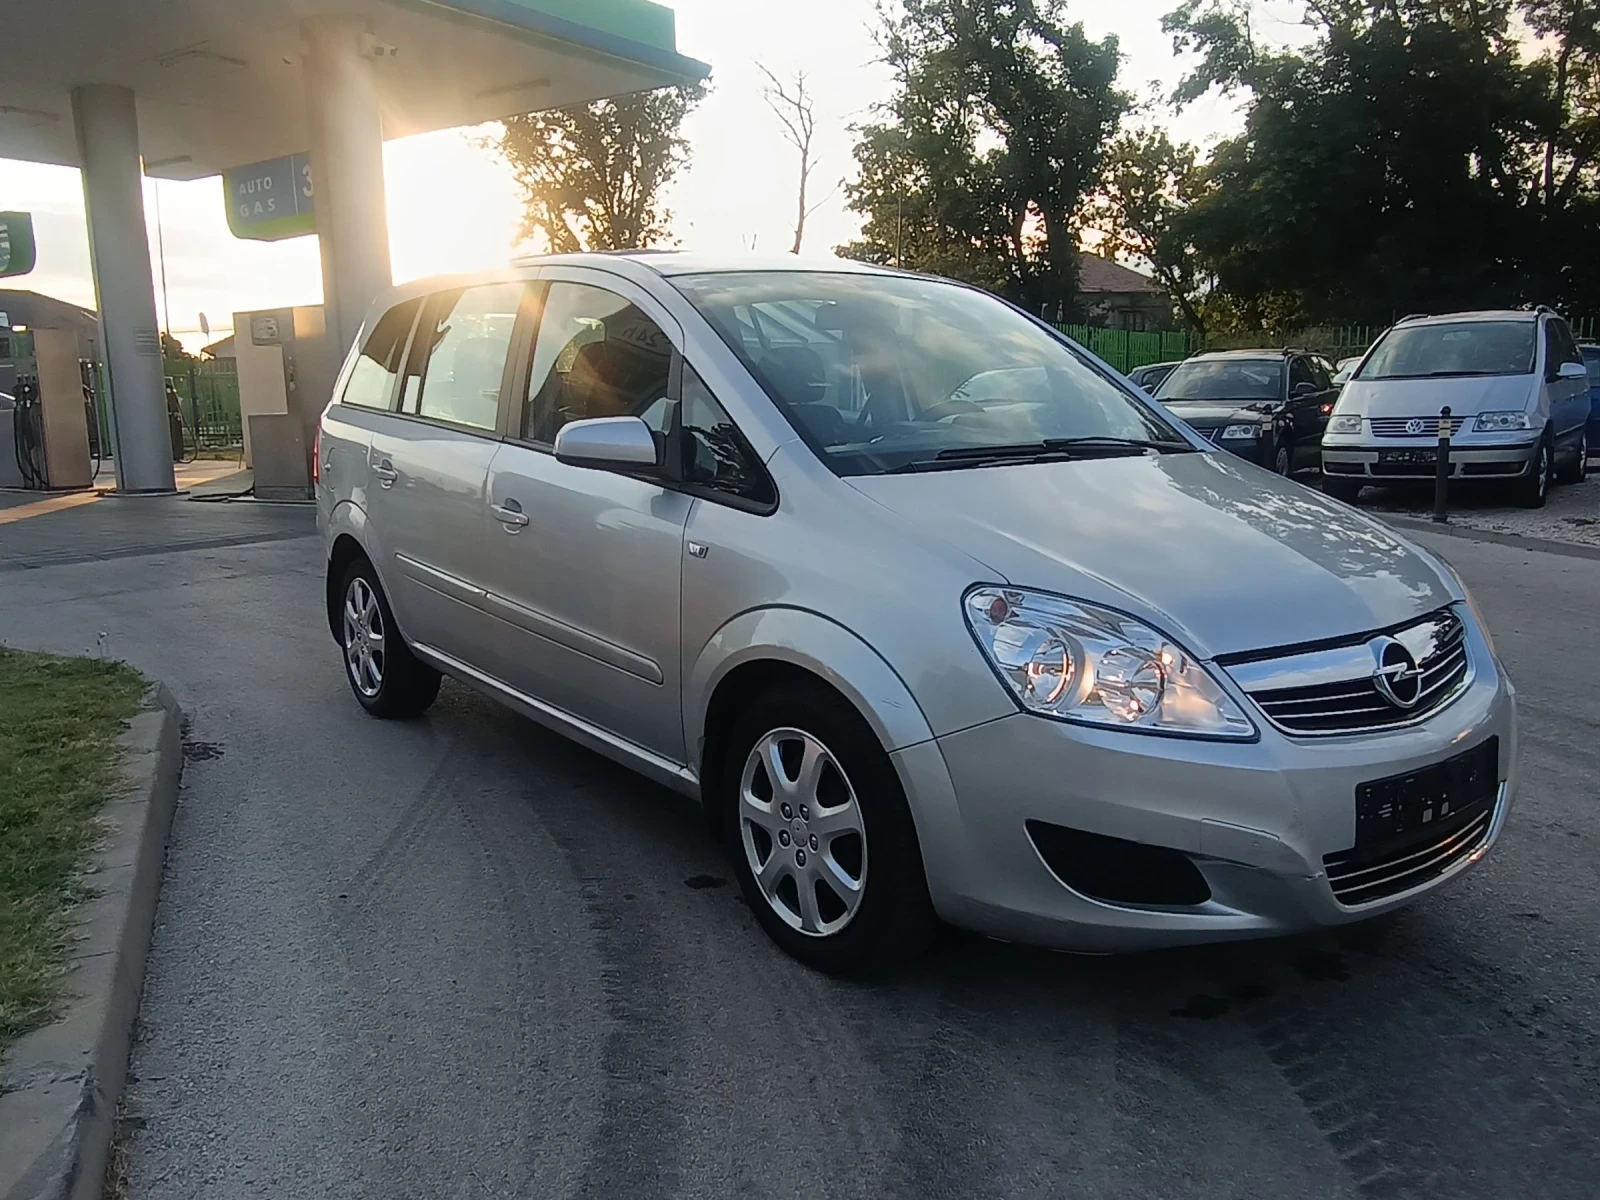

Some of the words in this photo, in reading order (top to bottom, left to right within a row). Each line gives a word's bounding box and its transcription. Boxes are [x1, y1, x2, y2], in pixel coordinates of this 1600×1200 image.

[239, 176, 273, 196] AUTO
[302, 164, 314, 197] 3
[239, 197, 276, 218] GAS
